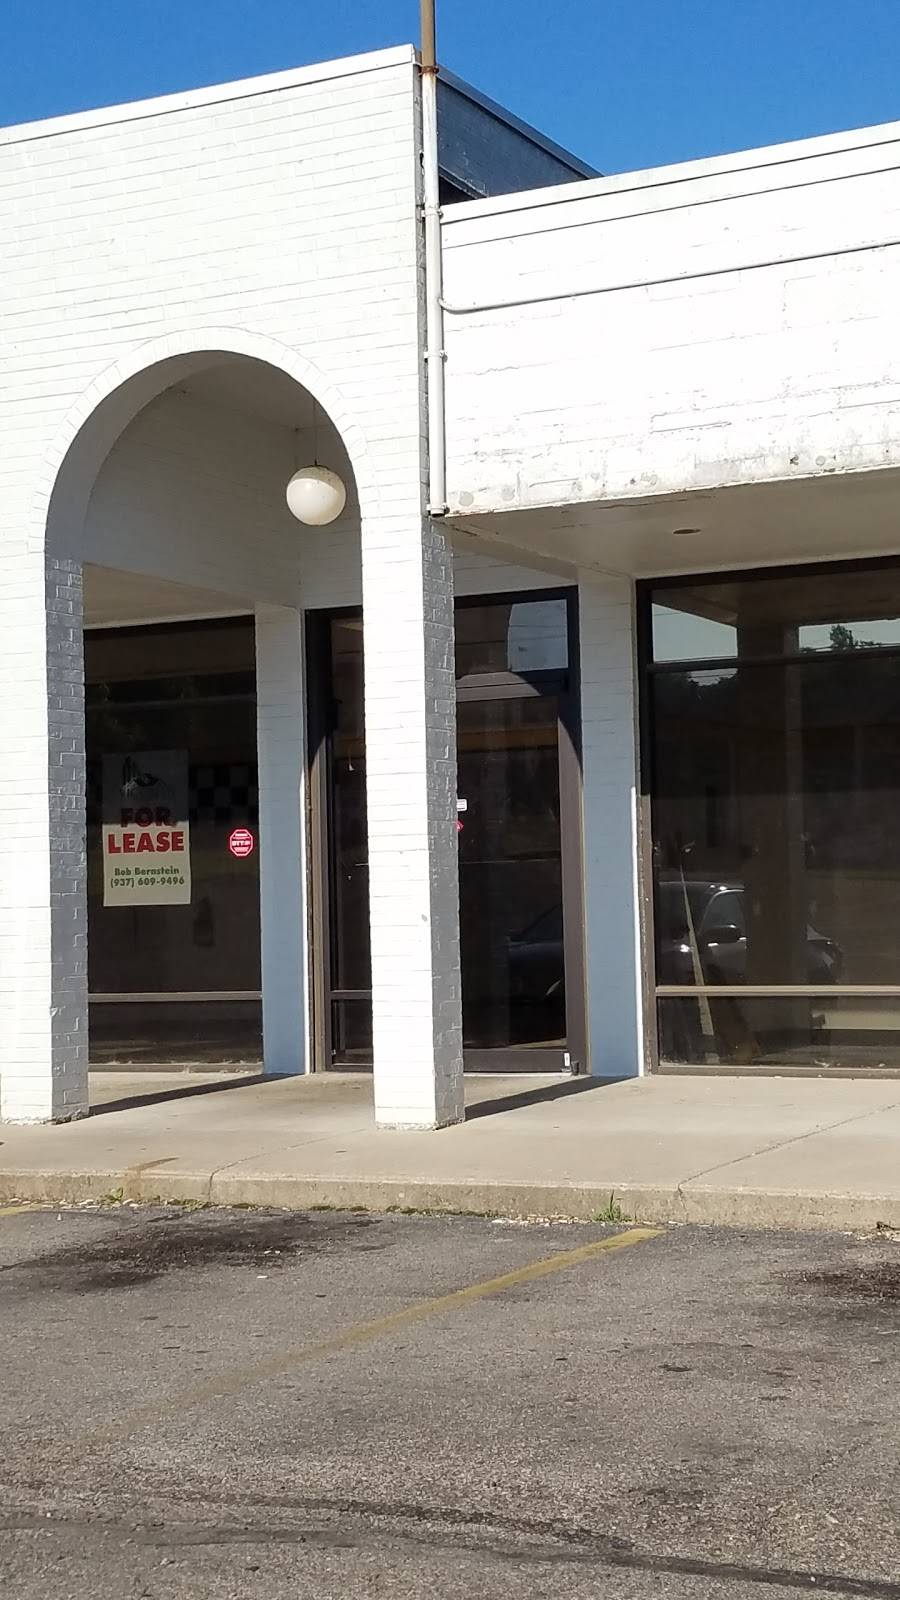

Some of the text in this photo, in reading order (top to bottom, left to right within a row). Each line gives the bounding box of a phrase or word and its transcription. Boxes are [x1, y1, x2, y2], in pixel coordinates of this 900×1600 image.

[120, 807, 177, 828] FOR
[108, 831, 185, 854] LEASE
[114, 866, 180, 876] Bob Bernstein
[110, 876, 185, 888] (937) 609-9496
